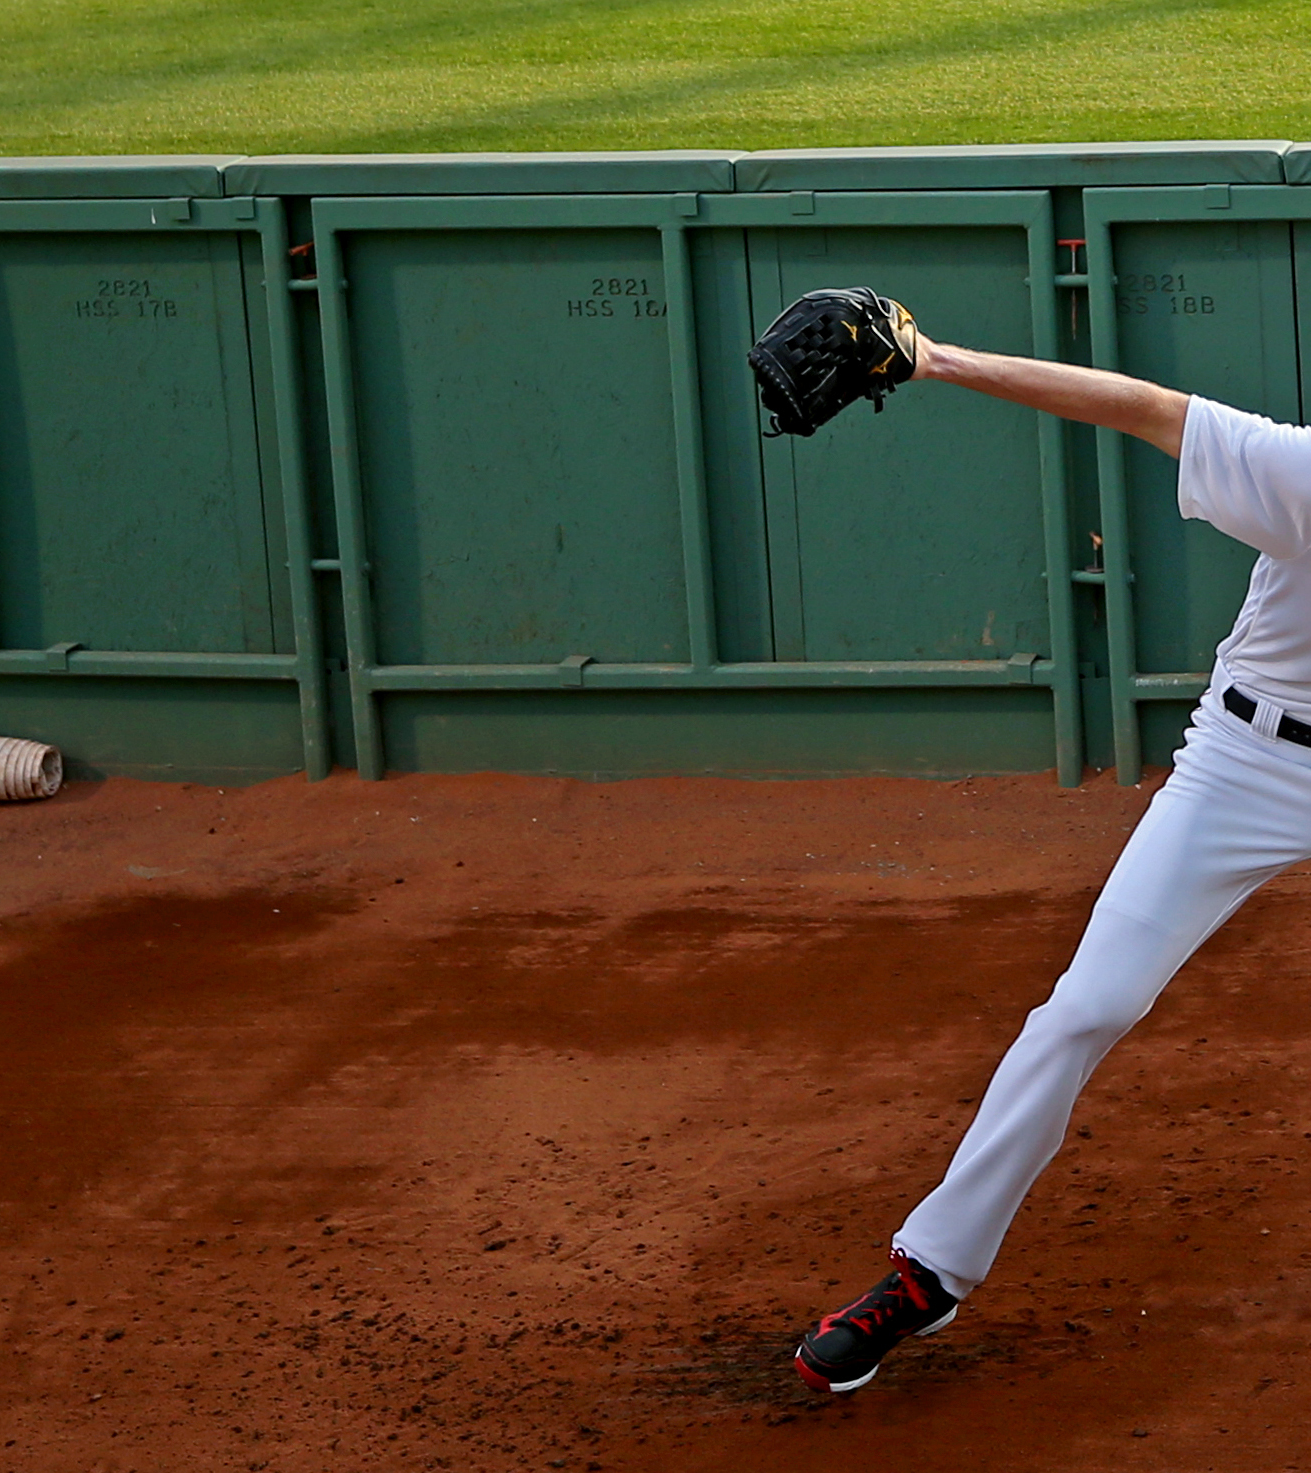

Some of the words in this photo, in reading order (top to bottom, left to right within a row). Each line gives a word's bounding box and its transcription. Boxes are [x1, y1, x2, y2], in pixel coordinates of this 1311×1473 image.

[98, 279, 152, 298] 2821
[592, 279, 650, 297] 2821
[1122, 274, 1187, 292] 2821
[76, 299, 120, 318] HSS
[138, 300, 177, 318] 17B
[567, 300, 614, 318] HSS
[1171, 296, 1215, 314] 18B
